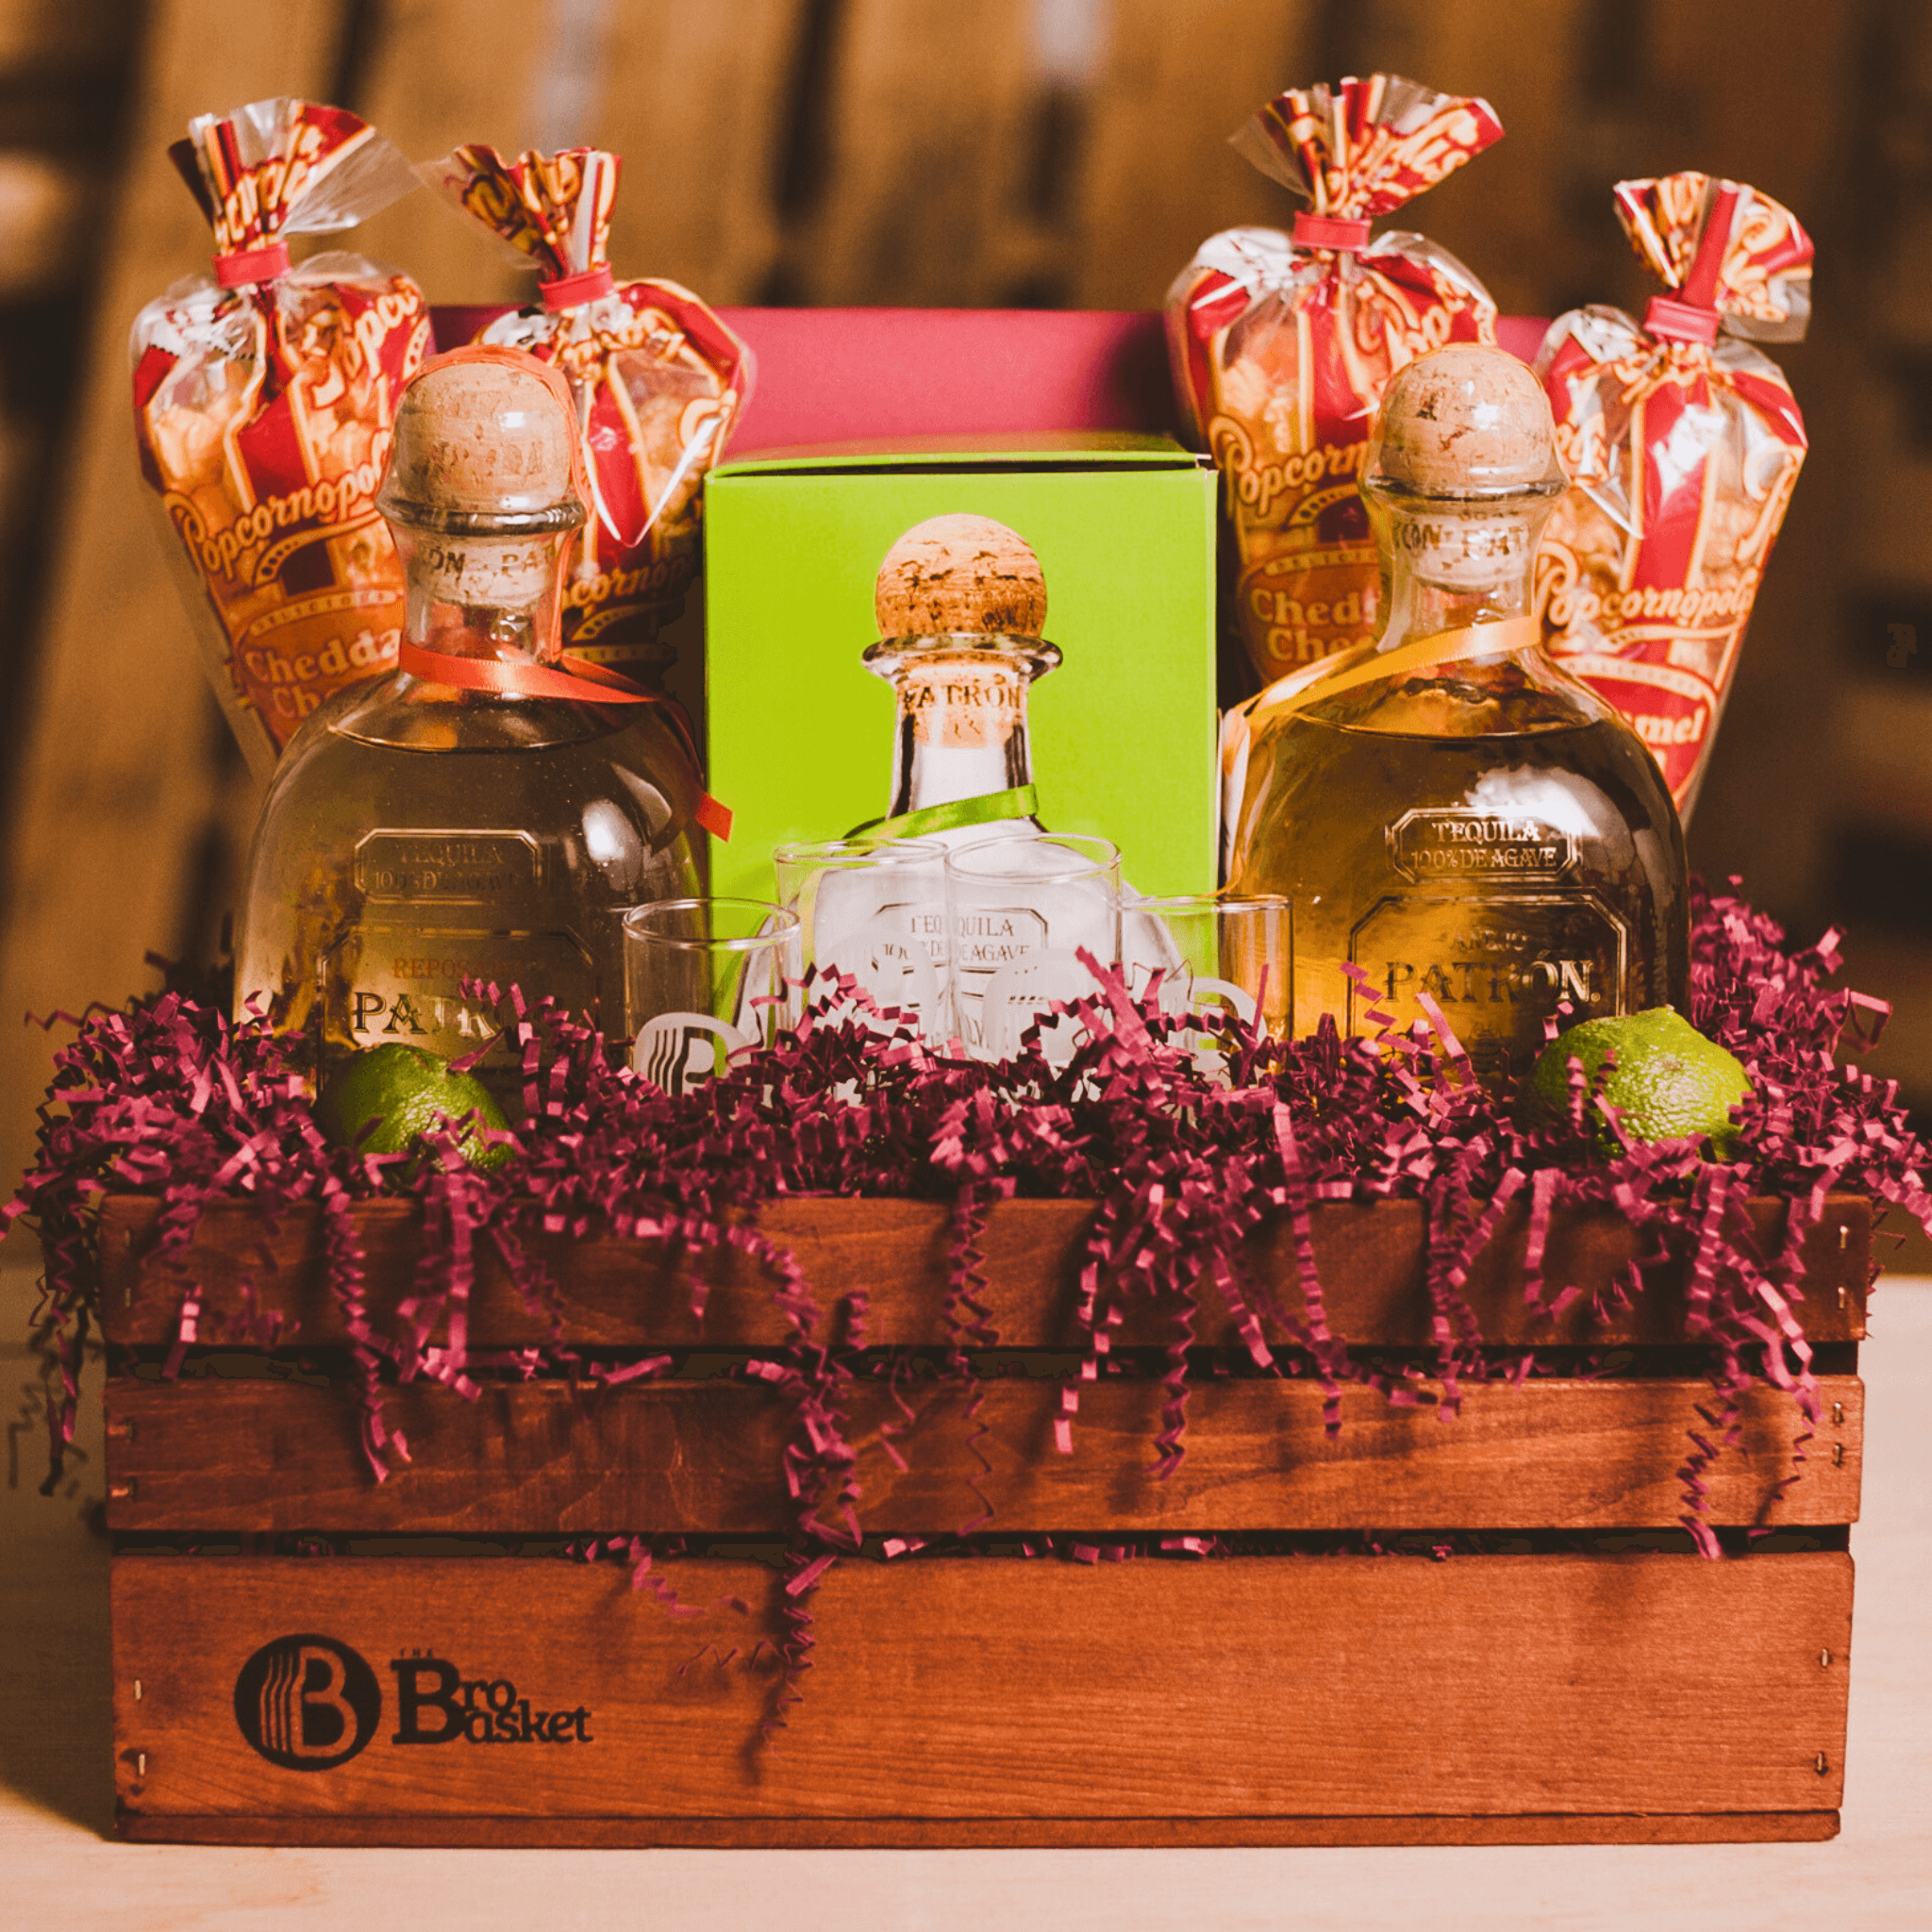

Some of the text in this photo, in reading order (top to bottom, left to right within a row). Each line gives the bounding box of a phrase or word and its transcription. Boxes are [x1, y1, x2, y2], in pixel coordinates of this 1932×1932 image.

[1432, 819, 1541, 845] TEQUILA
[396, 842, 505, 867] TEQUILA
[1411, 847, 1557, 870] 100% DE AGAVE
